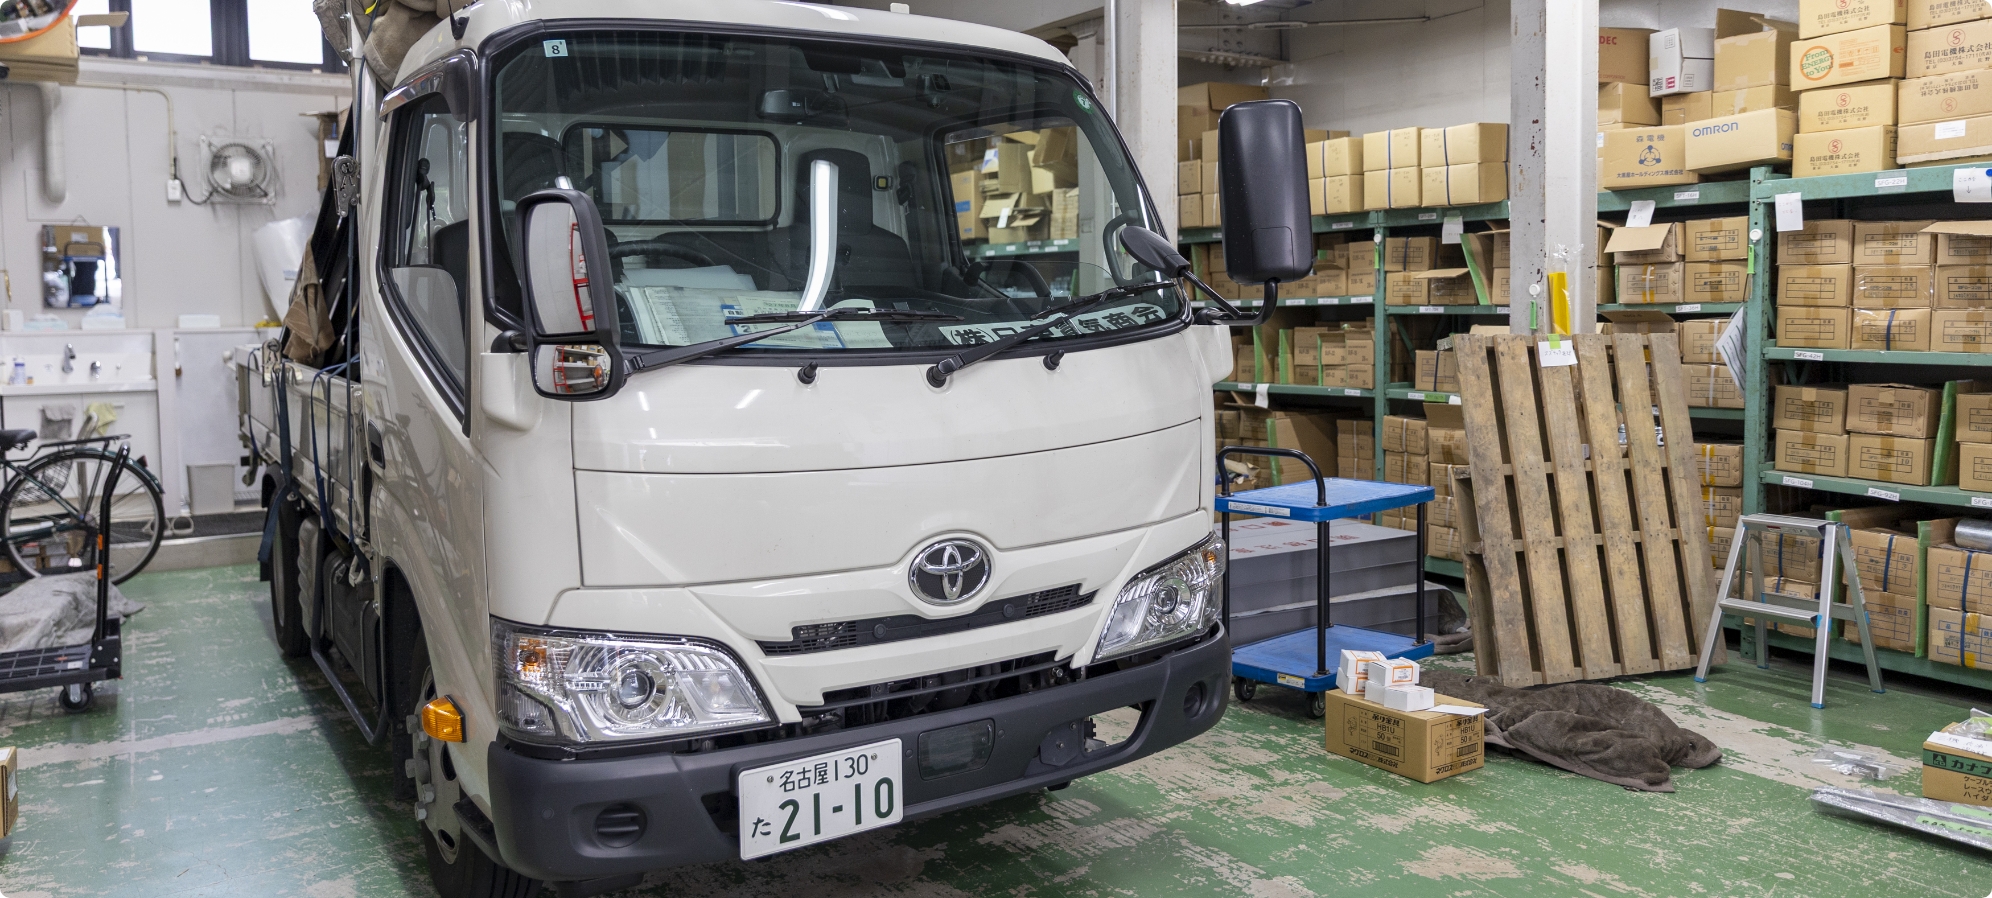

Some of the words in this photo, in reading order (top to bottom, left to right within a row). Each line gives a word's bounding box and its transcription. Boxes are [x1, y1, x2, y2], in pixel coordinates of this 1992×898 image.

[1817, 5, 1870, 20] 島田電機株式会社
[551, 44, 560, 54] 8
[1804, 48, 1829, 62] From
[1801, 53, 1835, 70] ENERGY
[1805, 69, 1815, 77] to
[1817, 106, 1869, 117] 島田電機株式会社
[1636, 134, 1665, 143] 森電機
[1809, 152, 1860, 163] 島田電機株式会社
[1372, 713, 1400, 727] 吊り金具
[1376, 722, 1396, 734] HB1U
[1461, 725, 1476, 735] HB1U
[1376, 732, 1386, 741] 50
[752, 817, 771, 838] た
[779, 777, 894, 844] 21-10
